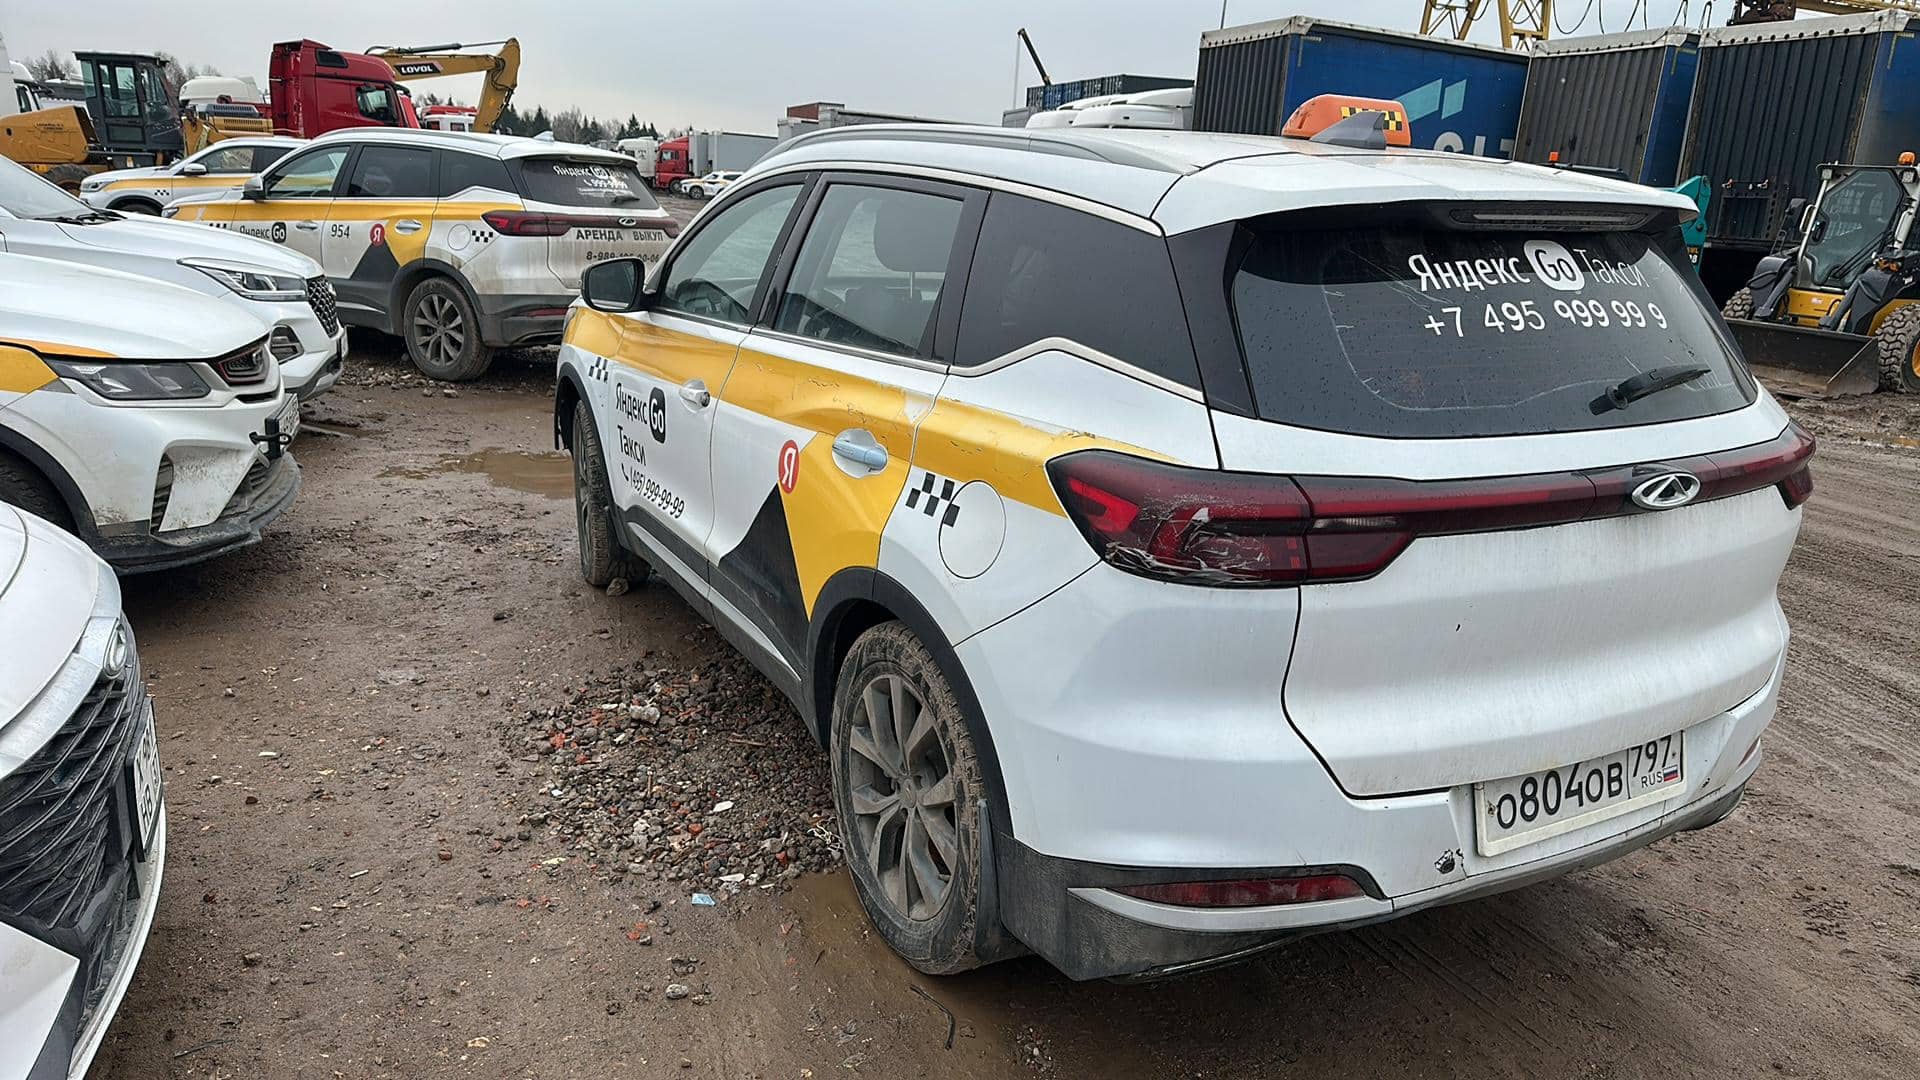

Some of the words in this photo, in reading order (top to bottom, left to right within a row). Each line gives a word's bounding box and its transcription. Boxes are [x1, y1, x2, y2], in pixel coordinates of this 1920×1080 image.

[401, 65, 433, 74] LOVOL
[272, 224, 286, 240] Go
[330, 223, 350, 239] 954
[576, 229, 623, 242] АРЕНДА
[632, 230, 664, 241] ВЫКУП
[1408, 253, 1531, 292] Яндекс
[1533, 248, 1578, 283] Go
[1573, 248, 1651, 288] Такси
[1424, 306, 1465, 338] +7
[1484, 300, 1546, 333] 495
[1553, 299, 1610, 328] 999
[615, 382, 648, 425] Яндекс
[650, 397, 665, 436] Go
[617, 425, 647, 467] Такси
[630, 467, 646, 495] (495)
[645, 479, 685, 519] 999-99-99
[1630, 734, 1671, 778] 797
[1641, 770, 1663, 789] RUS
